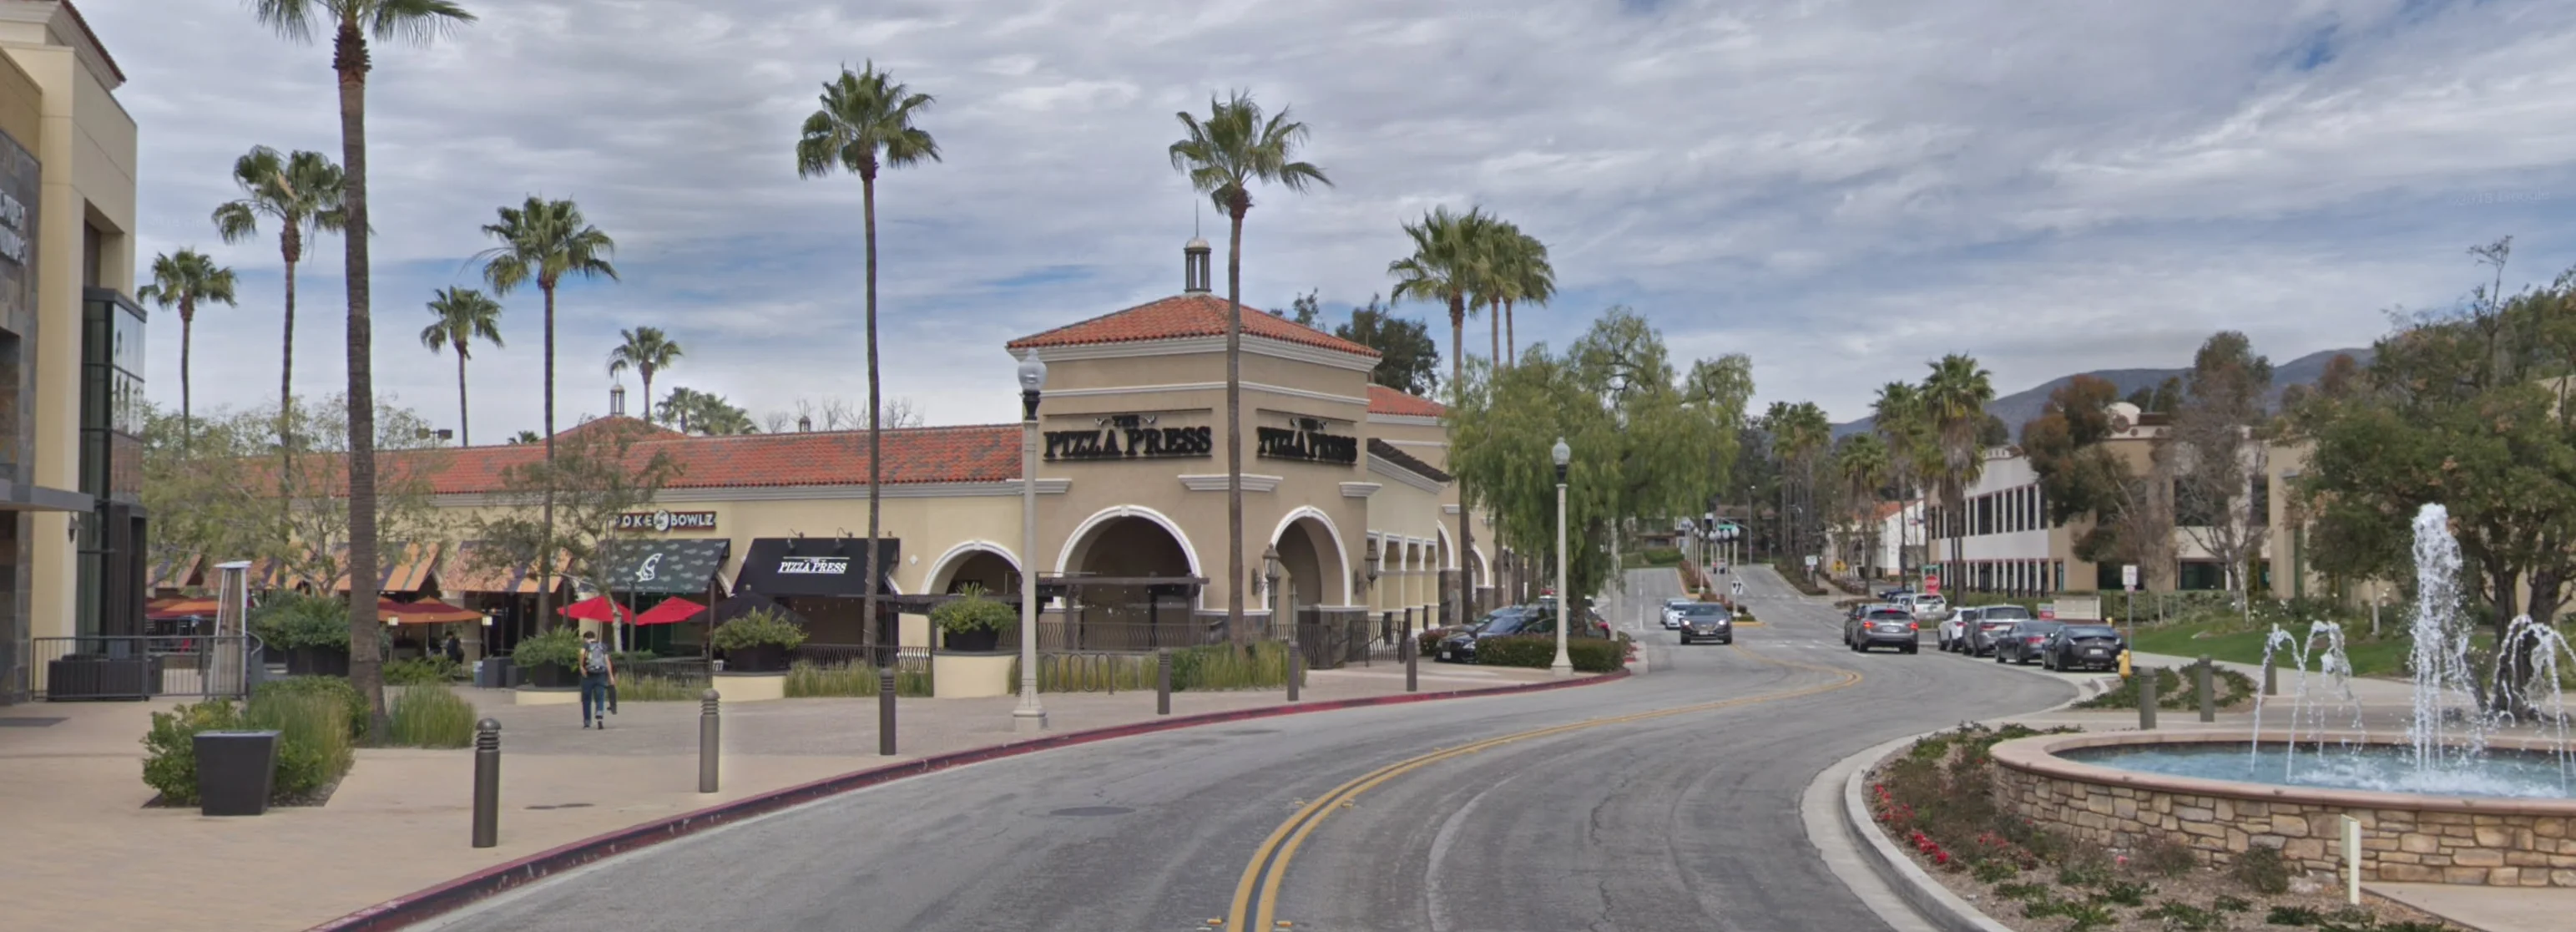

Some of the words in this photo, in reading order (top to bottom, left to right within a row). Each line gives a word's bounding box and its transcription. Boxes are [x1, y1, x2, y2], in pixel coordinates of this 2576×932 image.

[1043, 429, 1123, 458] PIZZA
[1124, 426, 1212, 456] PRESS
[670, 514, 714, 526] BOWLZ
[778, 561, 810, 573] PIZZA
[811, 562, 847, 574] PRESS
